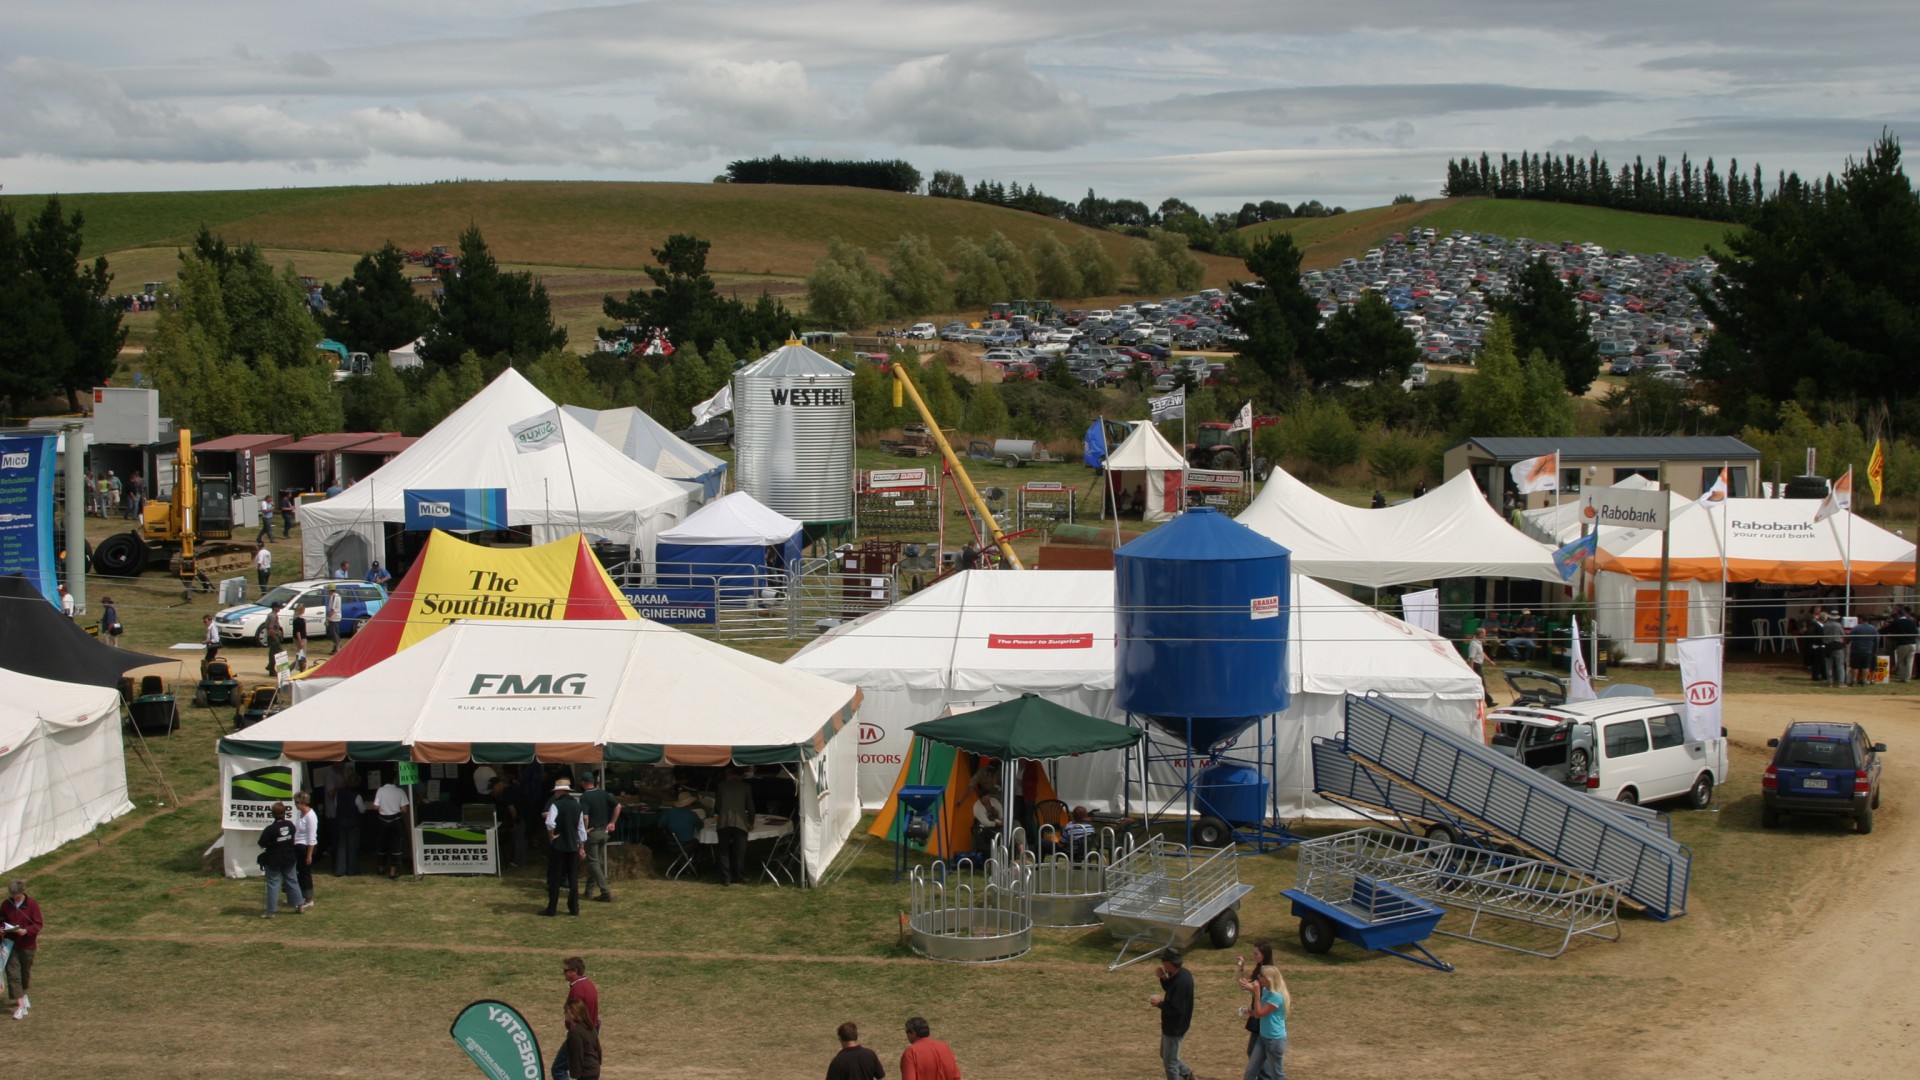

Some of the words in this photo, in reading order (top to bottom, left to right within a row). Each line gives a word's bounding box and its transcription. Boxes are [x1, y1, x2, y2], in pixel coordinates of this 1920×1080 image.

[770, 389, 845, 406] WESTEEL
[1601, 505, 1656, 523] Rabobank
[1731, 520, 1813, 531] Rabobank
[469, 570, 518, 592] The
[626, 595, 669, 604] RAKAIA
[420, 594, 555, 620] Southland
[468, 673, 588, 695] FMG
[860, 727, 877, 739] IA
[230, 811, 293, 819] FARMES
[231, 804, 293, 812] FEDERAD
